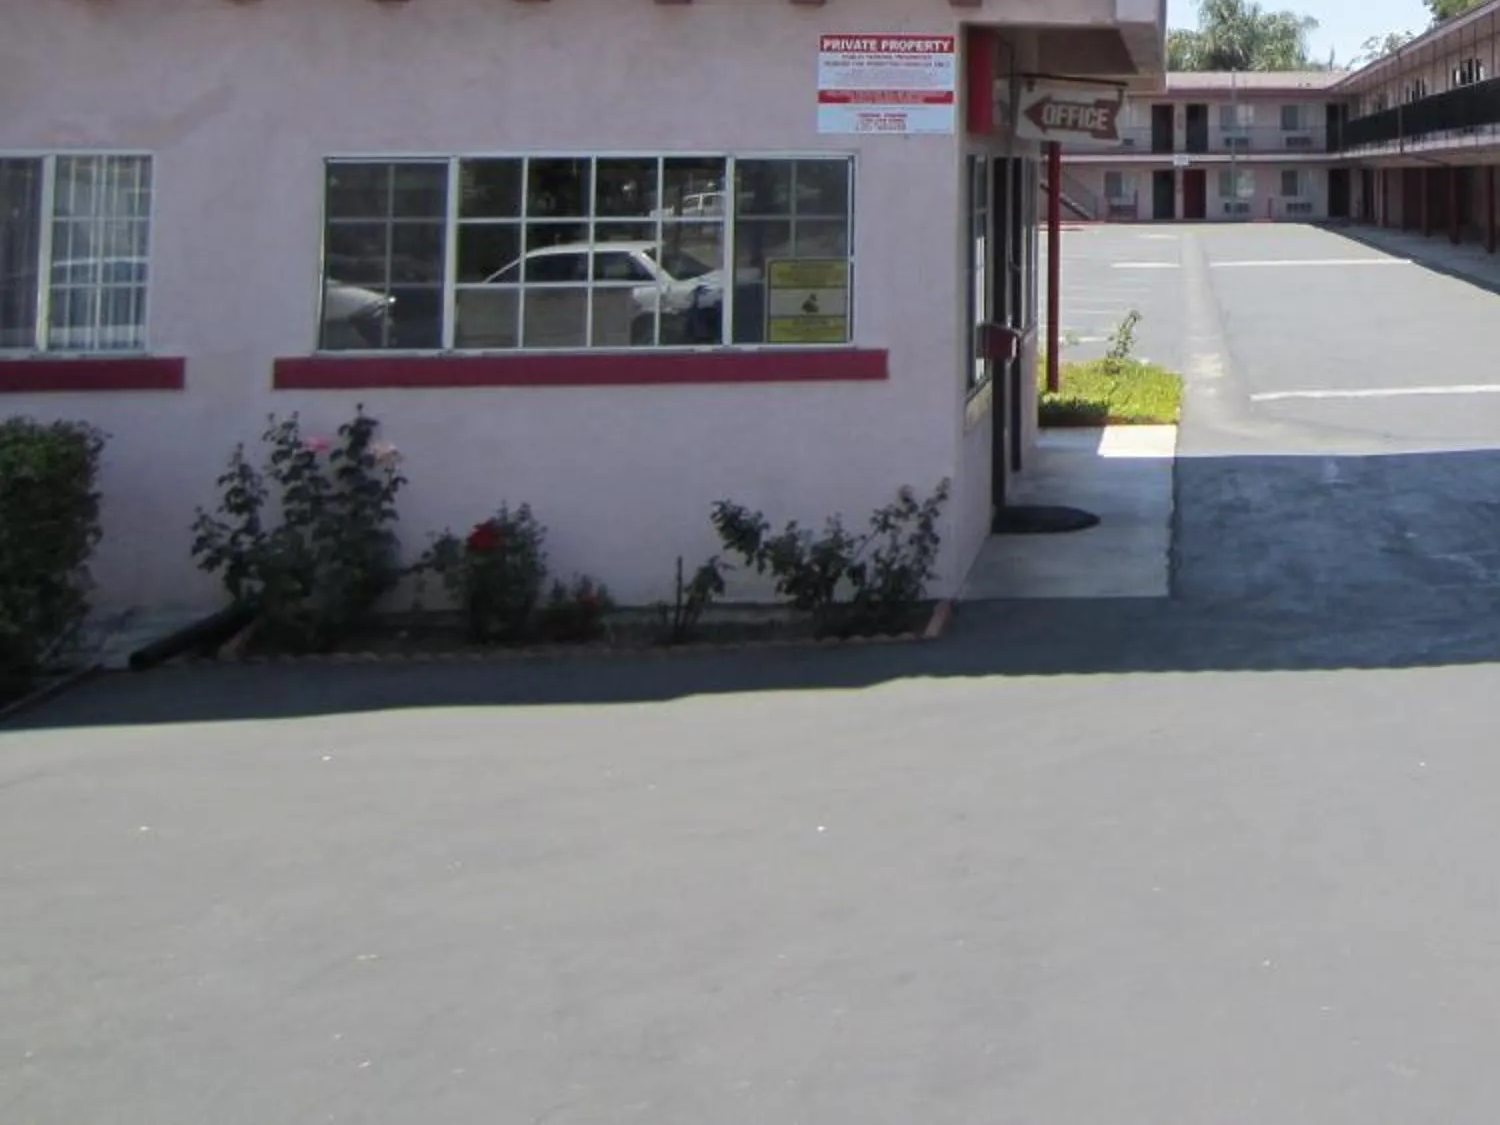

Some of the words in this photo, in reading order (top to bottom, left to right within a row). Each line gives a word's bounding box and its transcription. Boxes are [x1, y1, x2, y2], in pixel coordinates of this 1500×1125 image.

[823, 38, 877, 51] PRIVATE
[881, 39, 950, 52] PROPERTY
[1041, 103, 1111, 131] OFFICE
